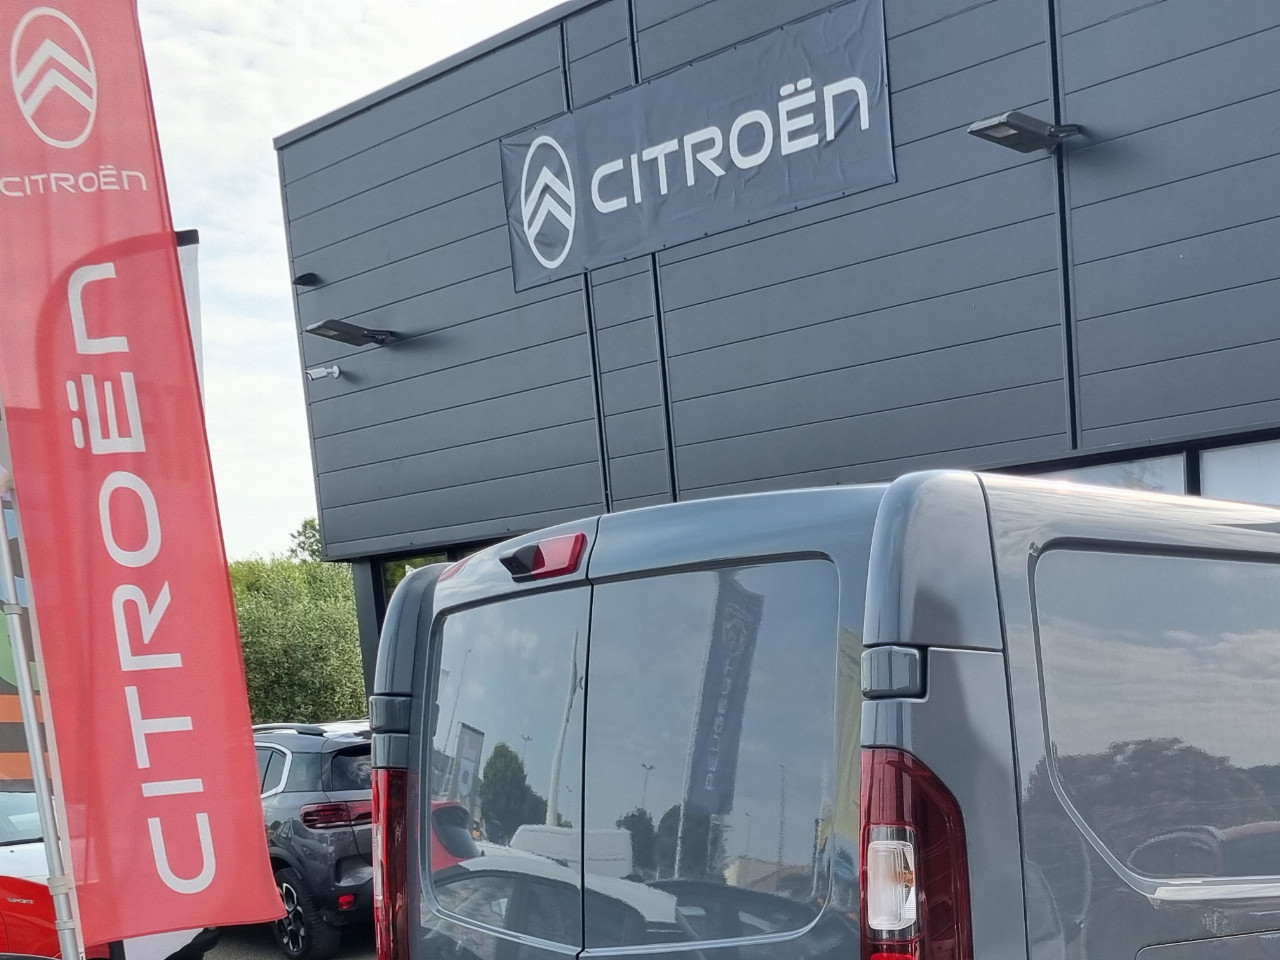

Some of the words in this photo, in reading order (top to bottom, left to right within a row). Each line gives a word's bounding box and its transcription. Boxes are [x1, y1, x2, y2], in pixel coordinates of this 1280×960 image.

[0, 165, 149, 197] CITROËN
[591, 77, 870, 214] CITROËN
[67, 261, 216, 895] CITROËN
